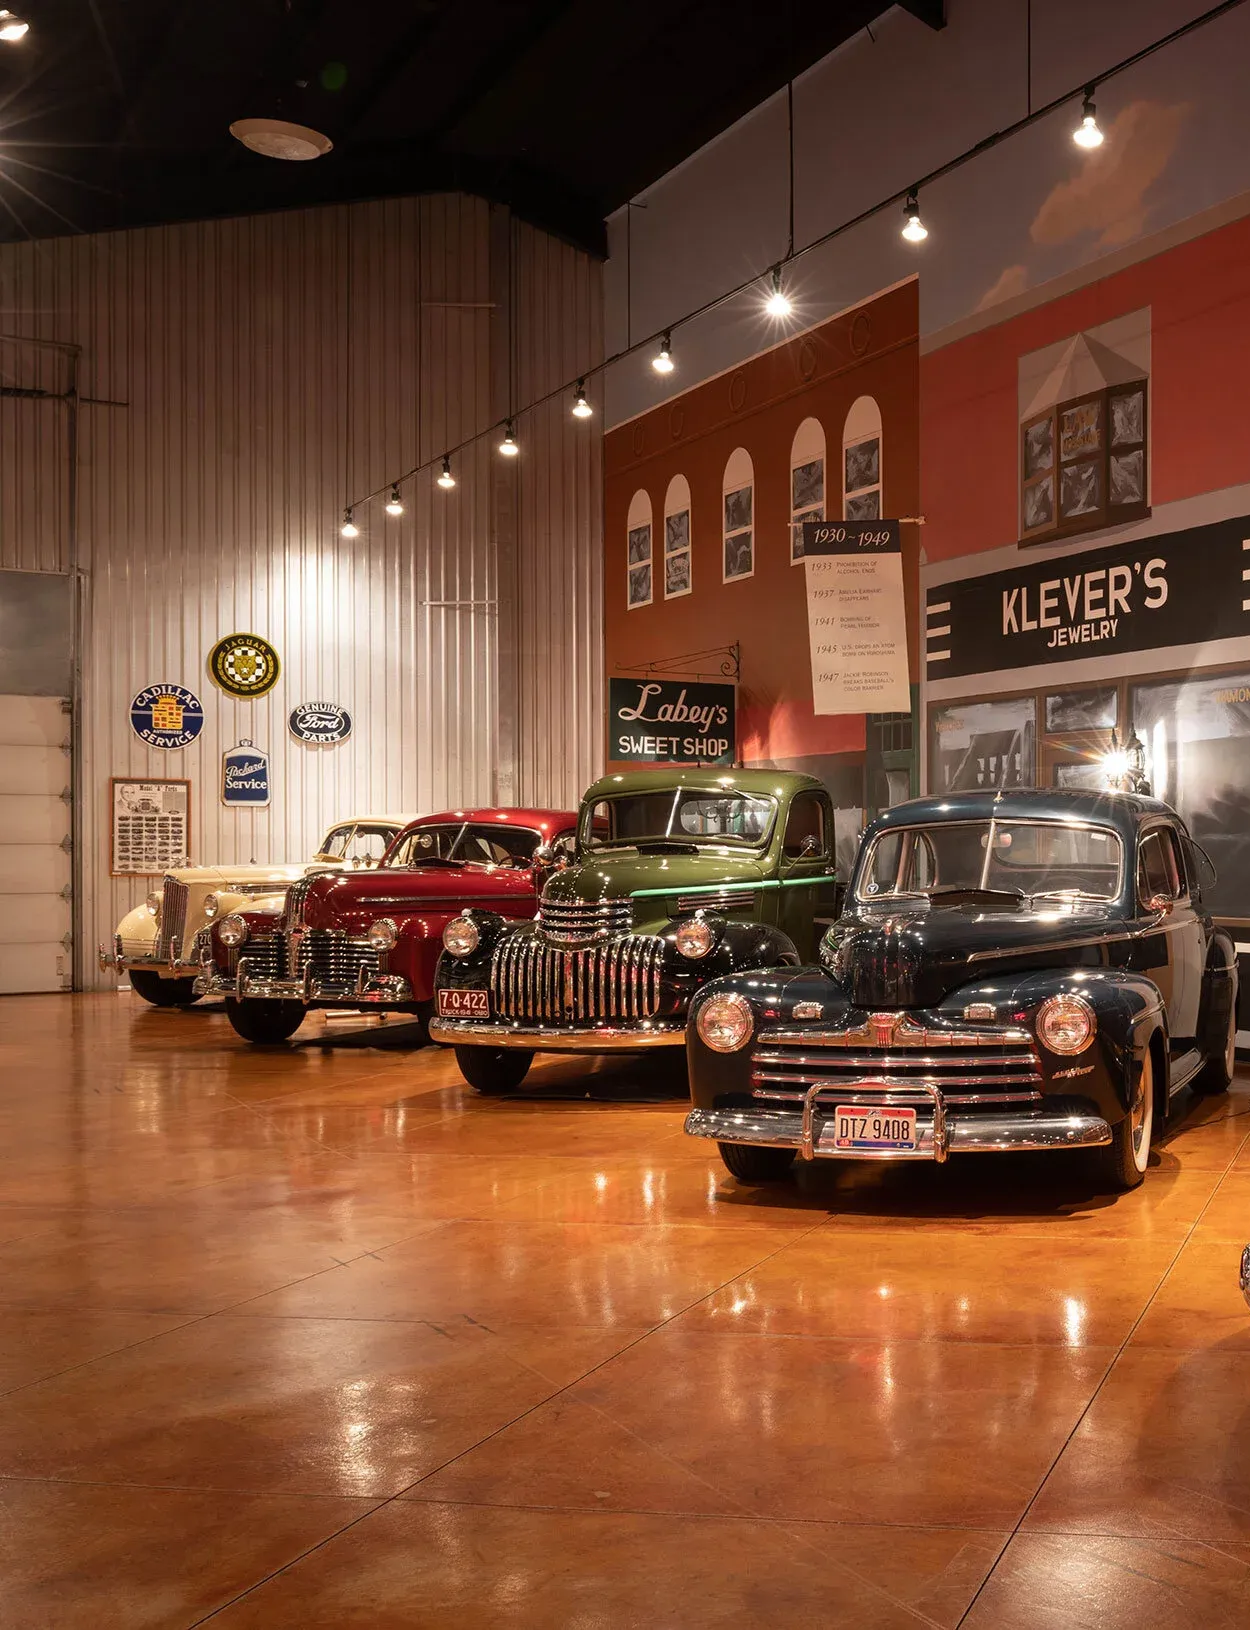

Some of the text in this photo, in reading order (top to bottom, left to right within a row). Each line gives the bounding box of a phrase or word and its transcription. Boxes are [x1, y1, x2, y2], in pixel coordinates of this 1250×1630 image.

[814, 527, 846, 544] 1930
[858, 531, 890, 547] 1949
[811, 562, 832, 571] 1933
[813, 589, 835, 599] 1937
[1002, 558, 1168, 636] KLEVER'S
[814, 617, 836, 627] 1941
[1047, 618, 1118, 648] JEWELRY
[224, 638, 267, 653] JAGUAR
[816, 644, 838, 655] 1945
[818, 672, 840, 683] 1947
[135, 685, 200, 710] CADILLAC
[296, 703, 345, 715] GENUINE
[618, 683, 728, 733] Labey's
[299, 713, 340, 729] Ford
[140, 728, 195, 748] SERVICE
[301, 732, 340, 742] PARTS
[618, 735, 728, 756] SWEET SHOP
[225, 760, 266, 779] Packard
[226, 779, 267, 789] Service
[840, 1117, 910, 1140] DTZ 9408
